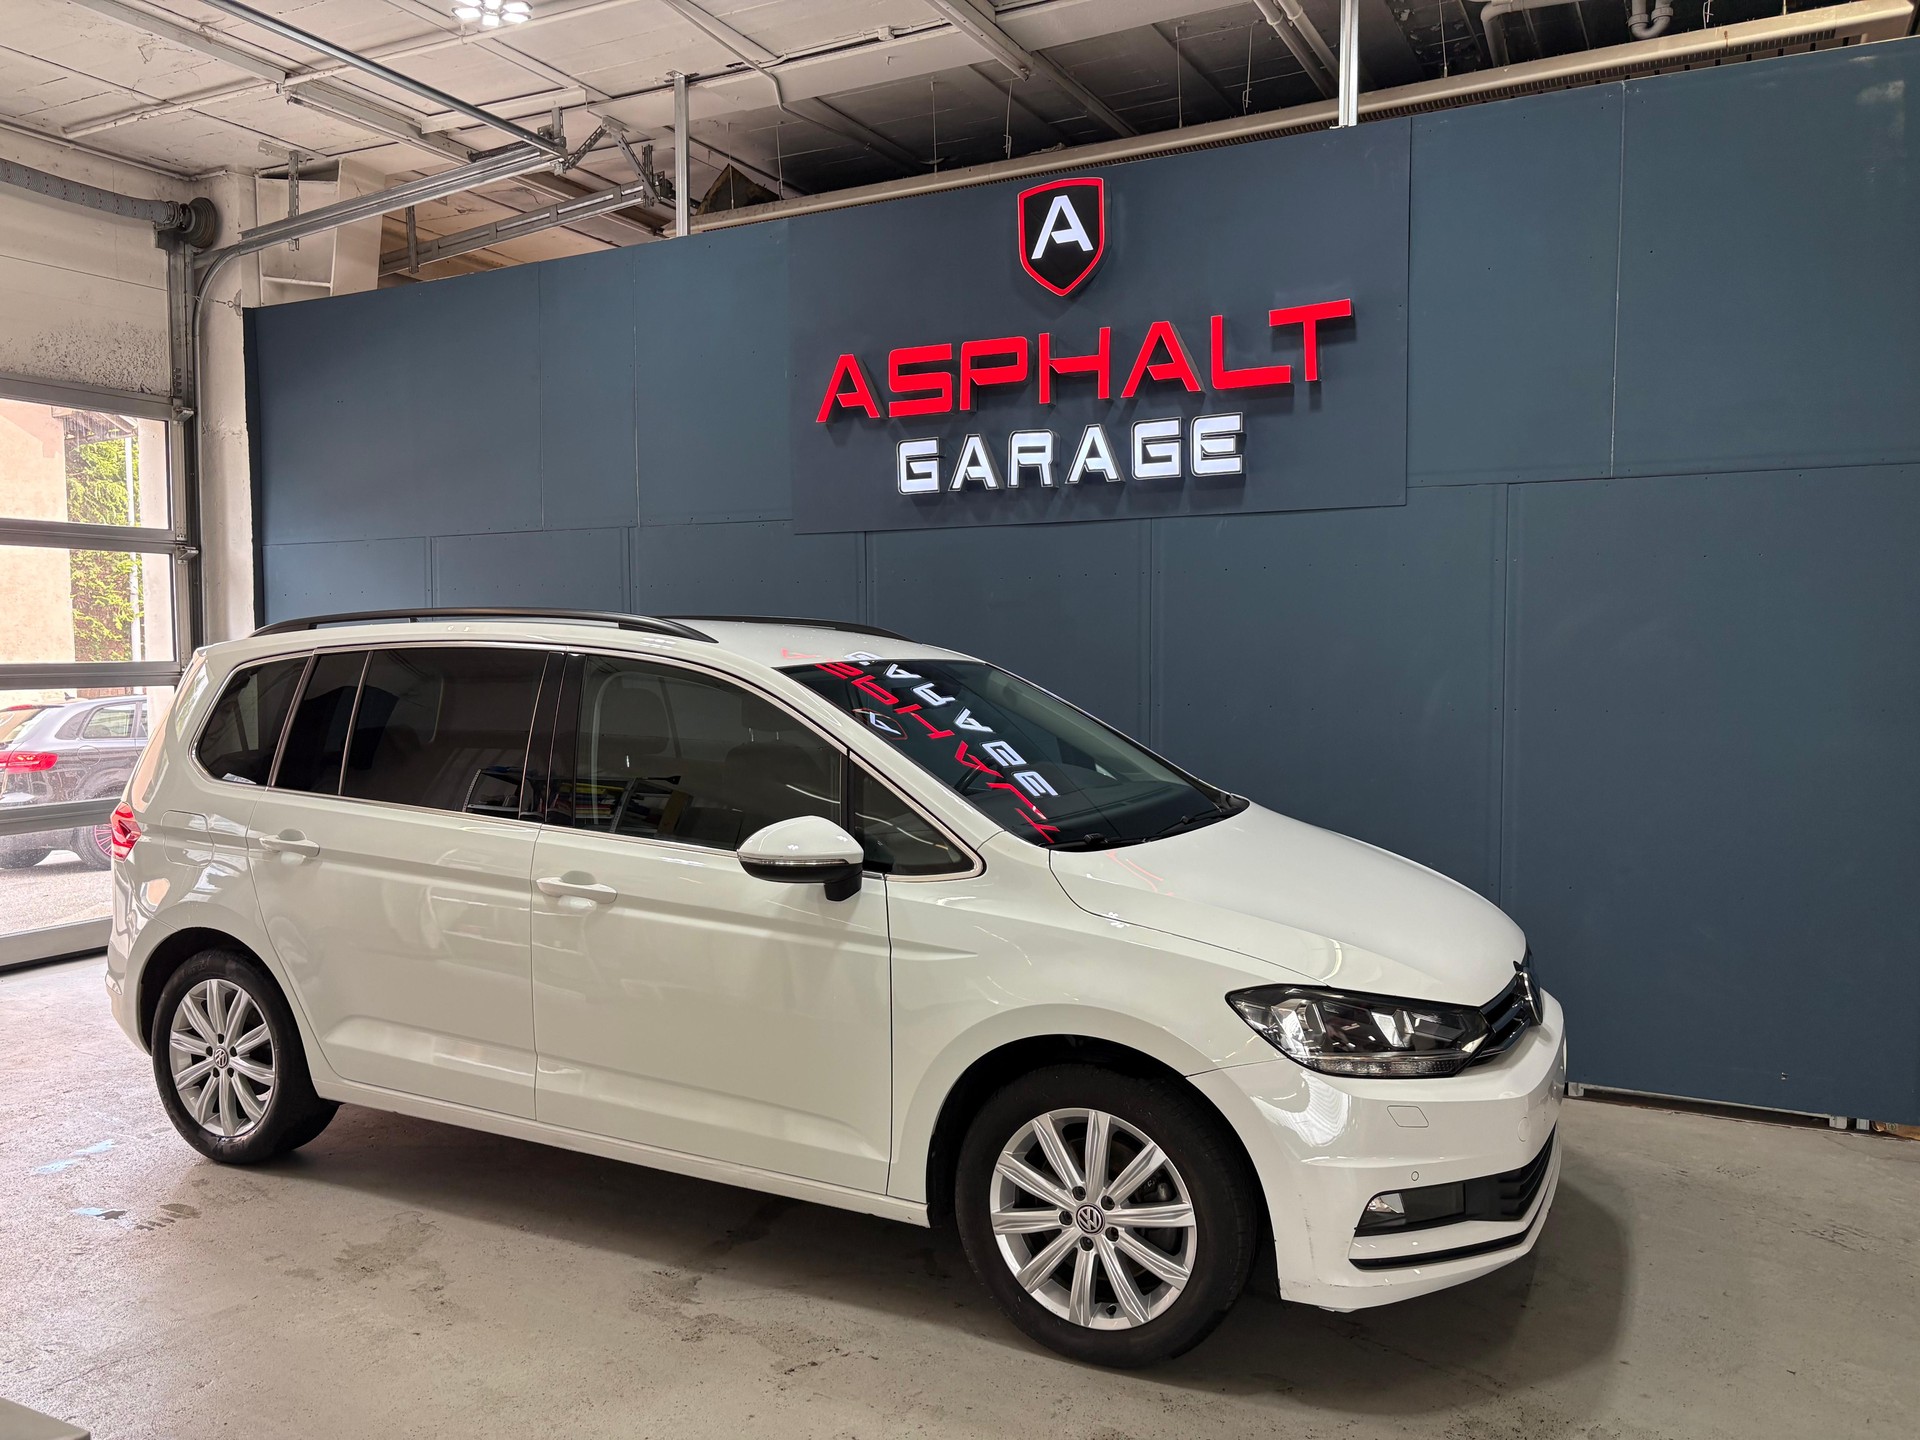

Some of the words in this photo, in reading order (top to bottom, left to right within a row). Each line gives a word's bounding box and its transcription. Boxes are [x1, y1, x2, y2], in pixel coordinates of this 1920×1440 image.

[1031, 194, 1094, 260] A
[815, 298, 1353, 423] ASPHALT
[896, 411, 1244, 496] GARAGE
